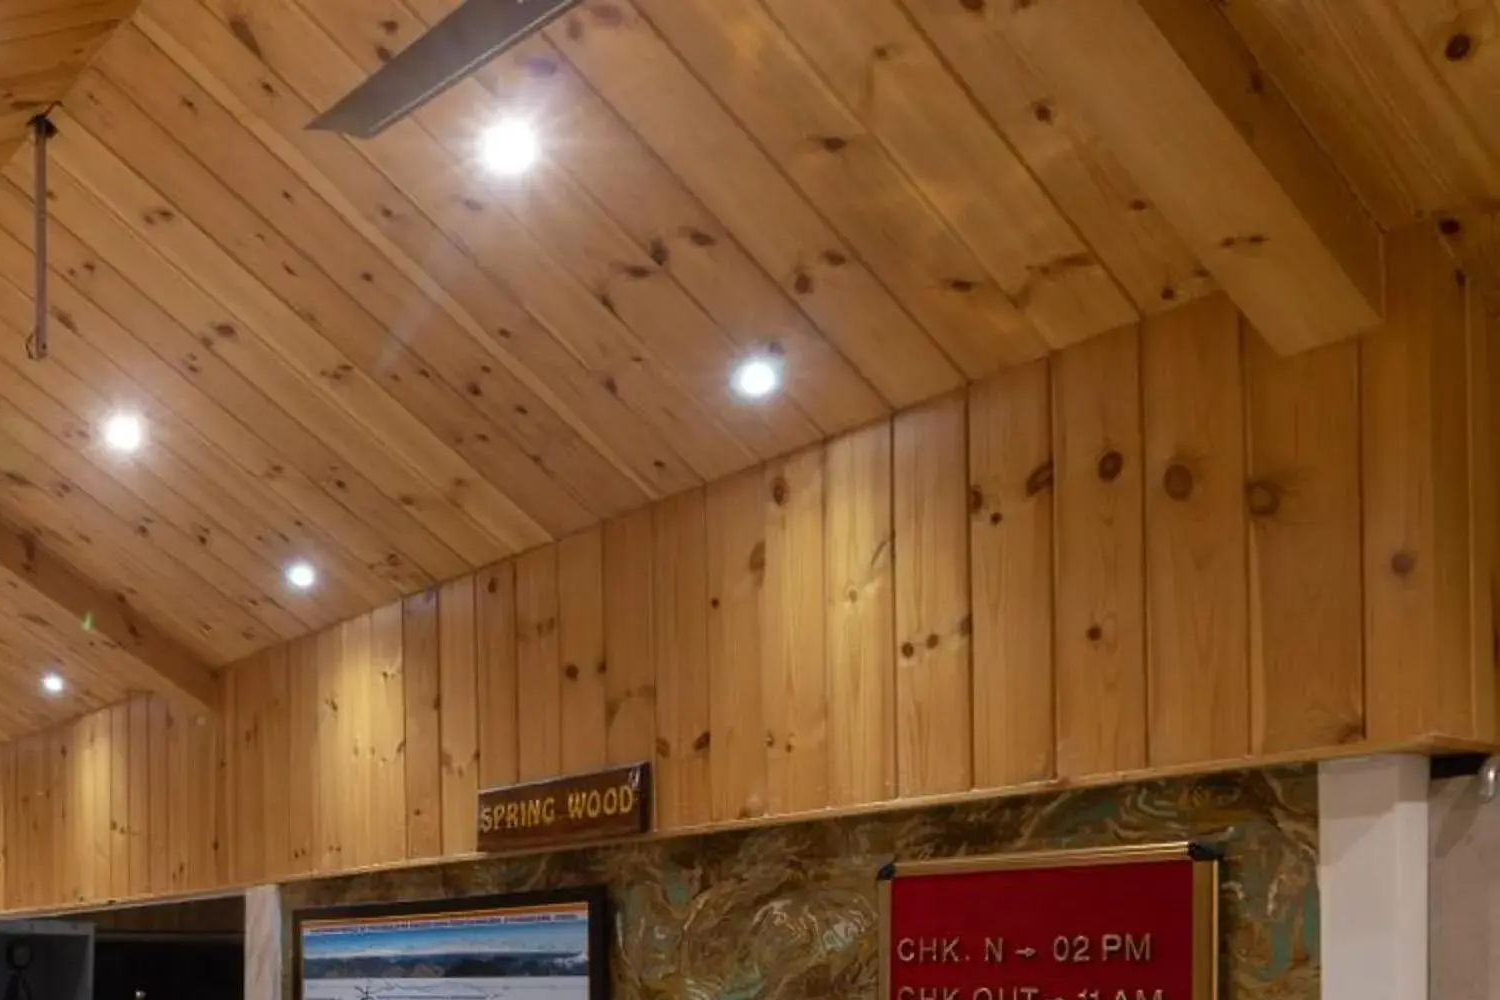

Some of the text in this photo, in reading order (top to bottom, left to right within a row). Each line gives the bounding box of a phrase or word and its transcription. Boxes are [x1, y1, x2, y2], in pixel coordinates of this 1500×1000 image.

[481, 784, 633, 832] SPRING WOOD
[896, 932, 1151, 963] CHK. N 02 PM
